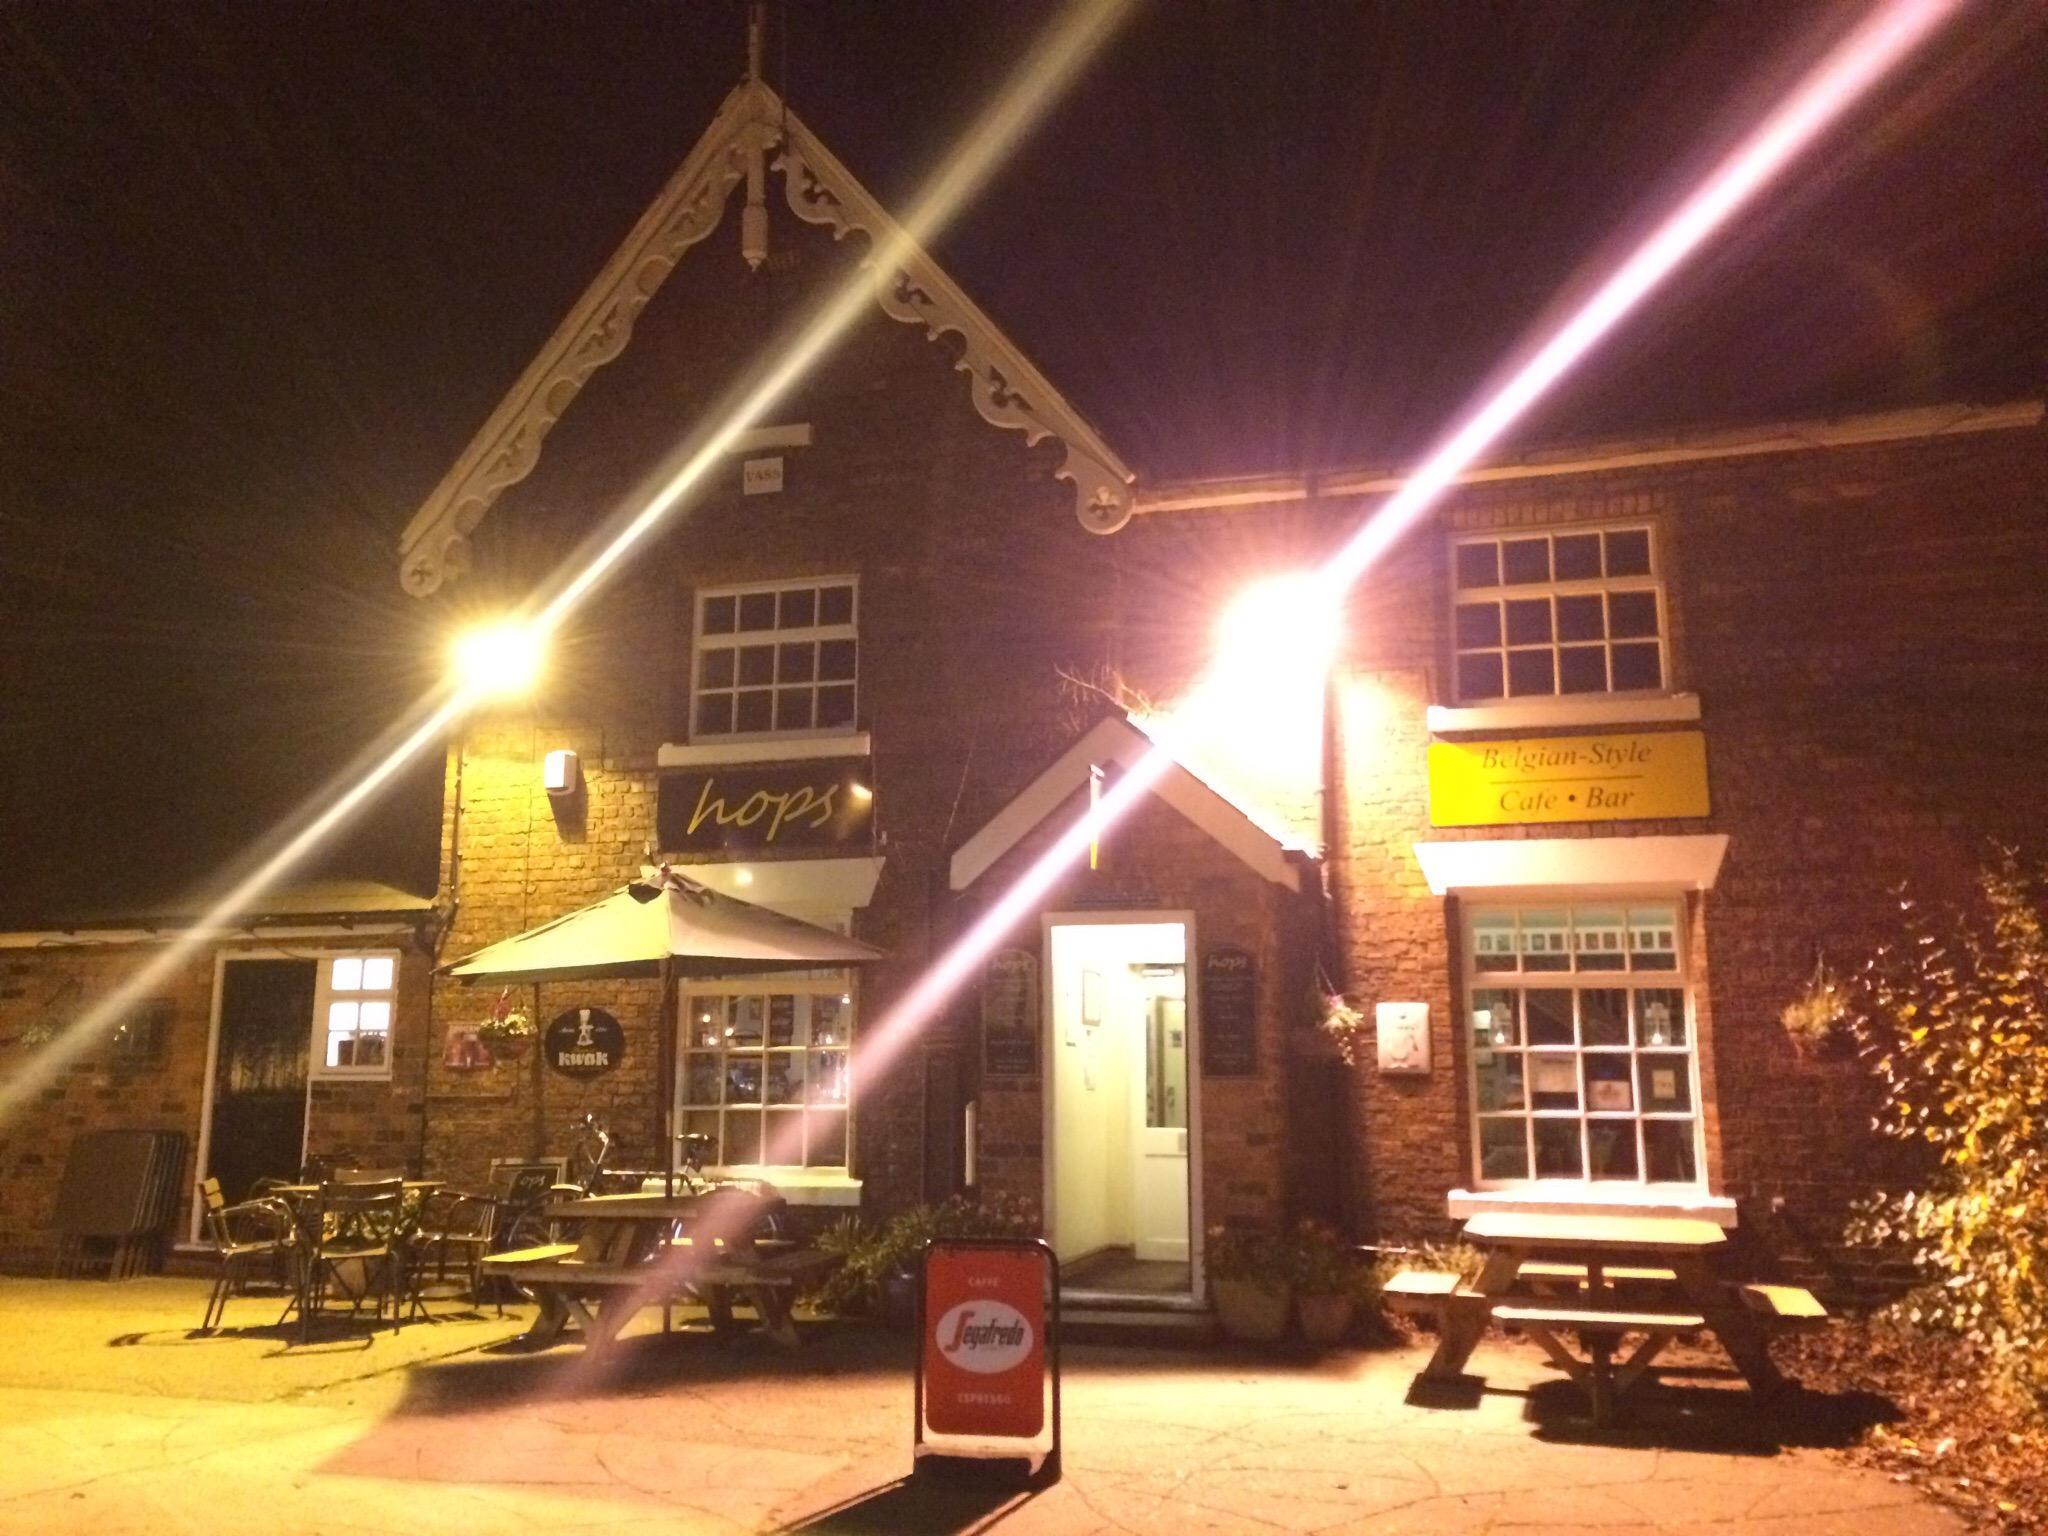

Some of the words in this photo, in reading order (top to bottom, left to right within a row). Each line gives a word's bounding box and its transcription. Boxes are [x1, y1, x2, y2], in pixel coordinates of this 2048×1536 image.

[1482, 741, 1652, 771] Belgian-Style
[687, 777, 839, 841] hops
[1586, 786, 1634, 809] Bar
